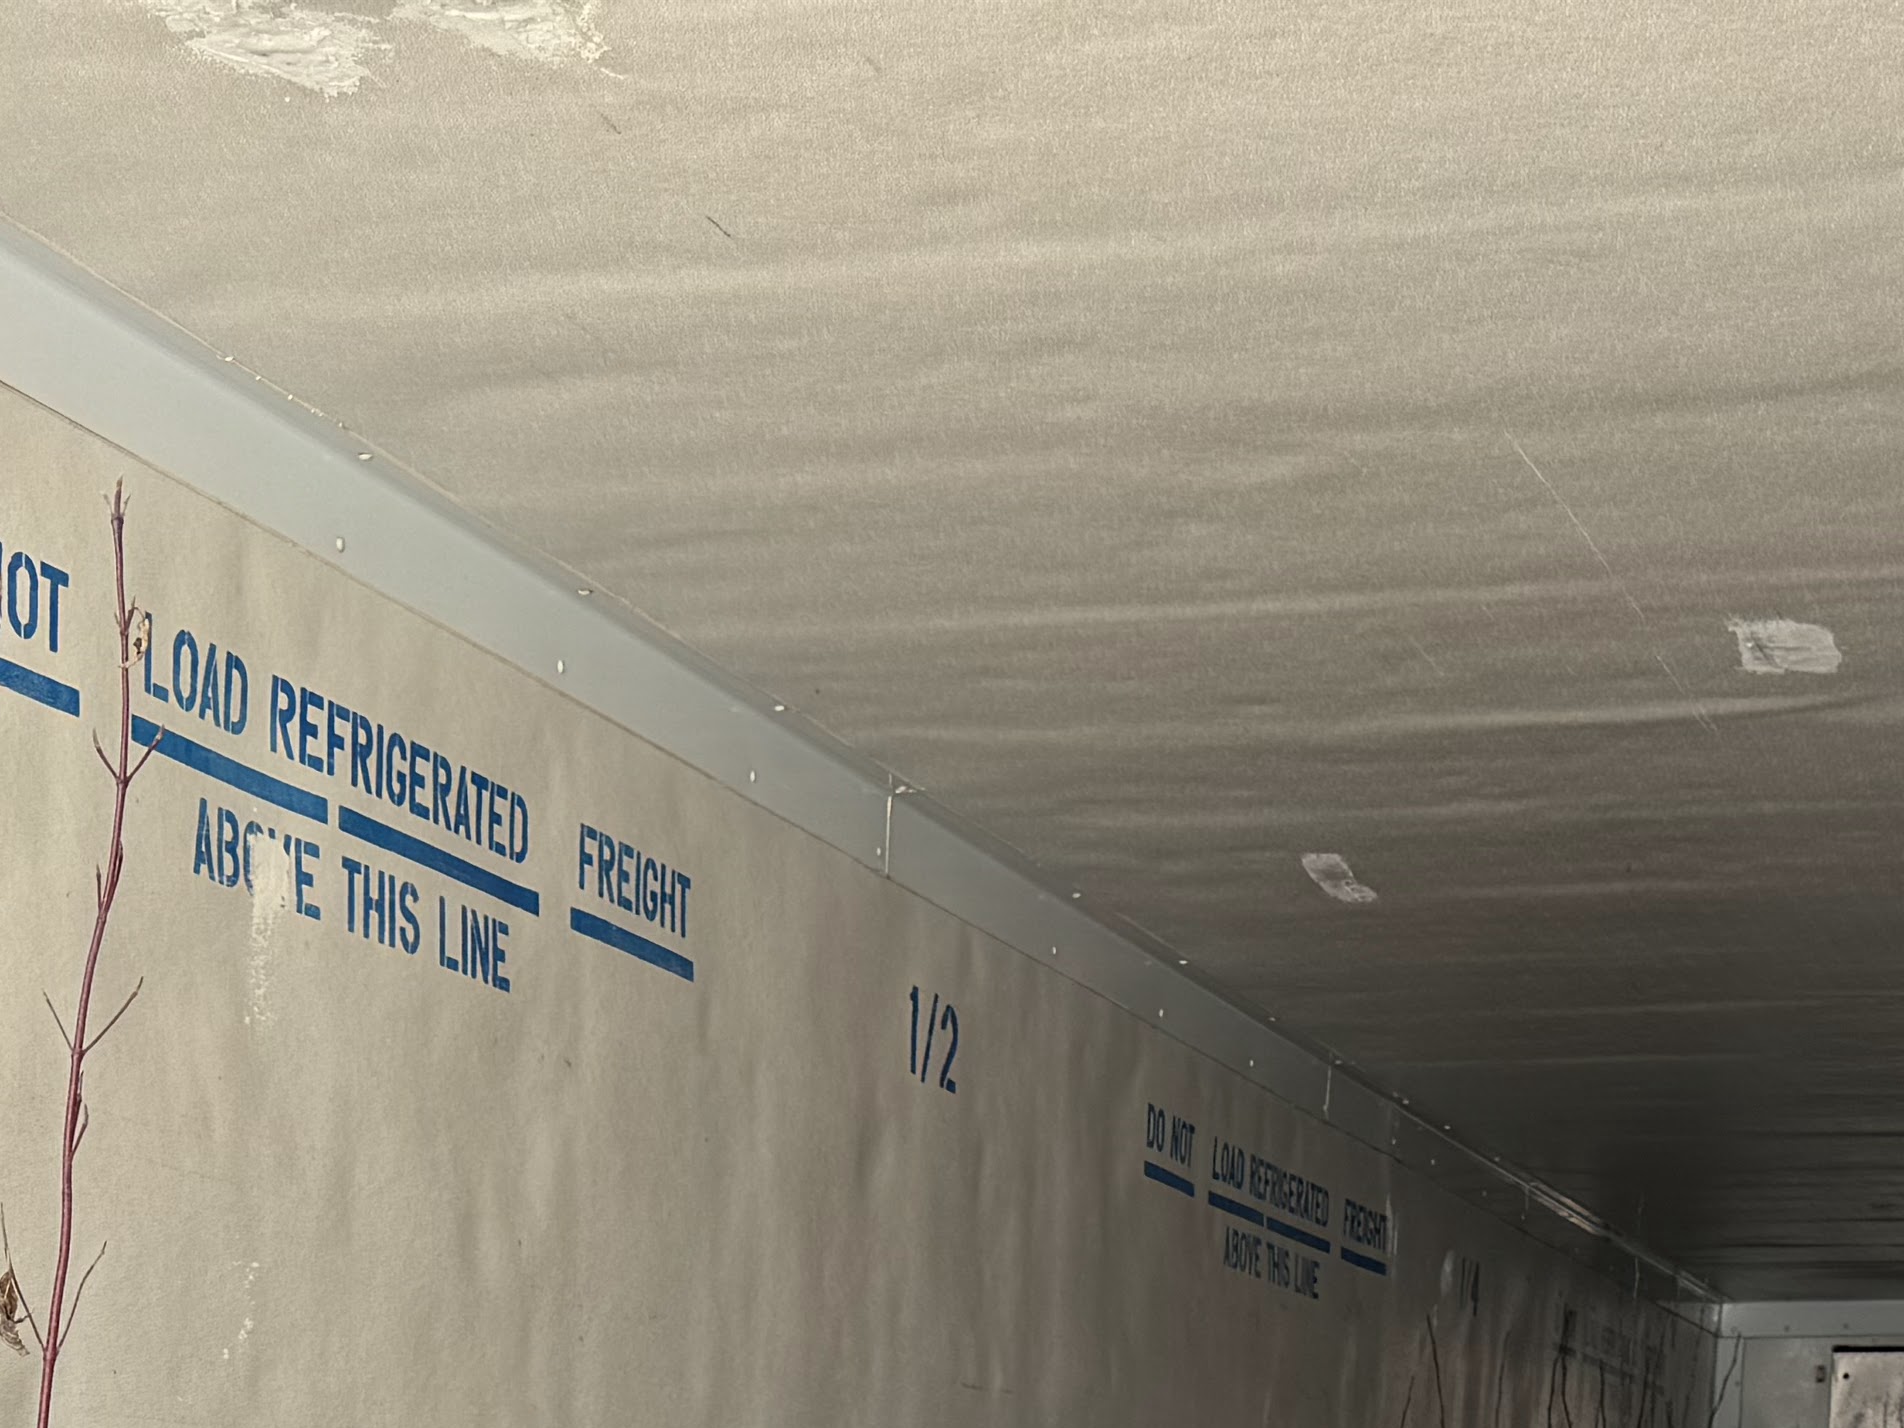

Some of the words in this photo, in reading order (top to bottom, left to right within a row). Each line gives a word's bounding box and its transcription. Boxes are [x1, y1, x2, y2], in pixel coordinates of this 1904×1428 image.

[144, 611, 248, 736] LOAD
[270, 674, 529, 865] REFRIGERATED
[579, 822, 691, 939] FREIGHT
[193, 797, 321, 921] ABOE
[341, 855, 421, 955] THIS
[439, 895, 511, 993] LINE
[909, 985, 959, 1094] 1/2
[1147, 1102, 1166, 1152] DO
[1170, 1115, 1195, 1168] NOT
[1212, 1136, 1245, 1190] LOAD
[1250, 1154, 1330, 1228] REFRIGERATED
[1343, 1198, 1388, 1254] FREIGHT
[1224, 1226, 1262, 1279] ABOVE
[1267, 1241, 1290, 1289] THIS
